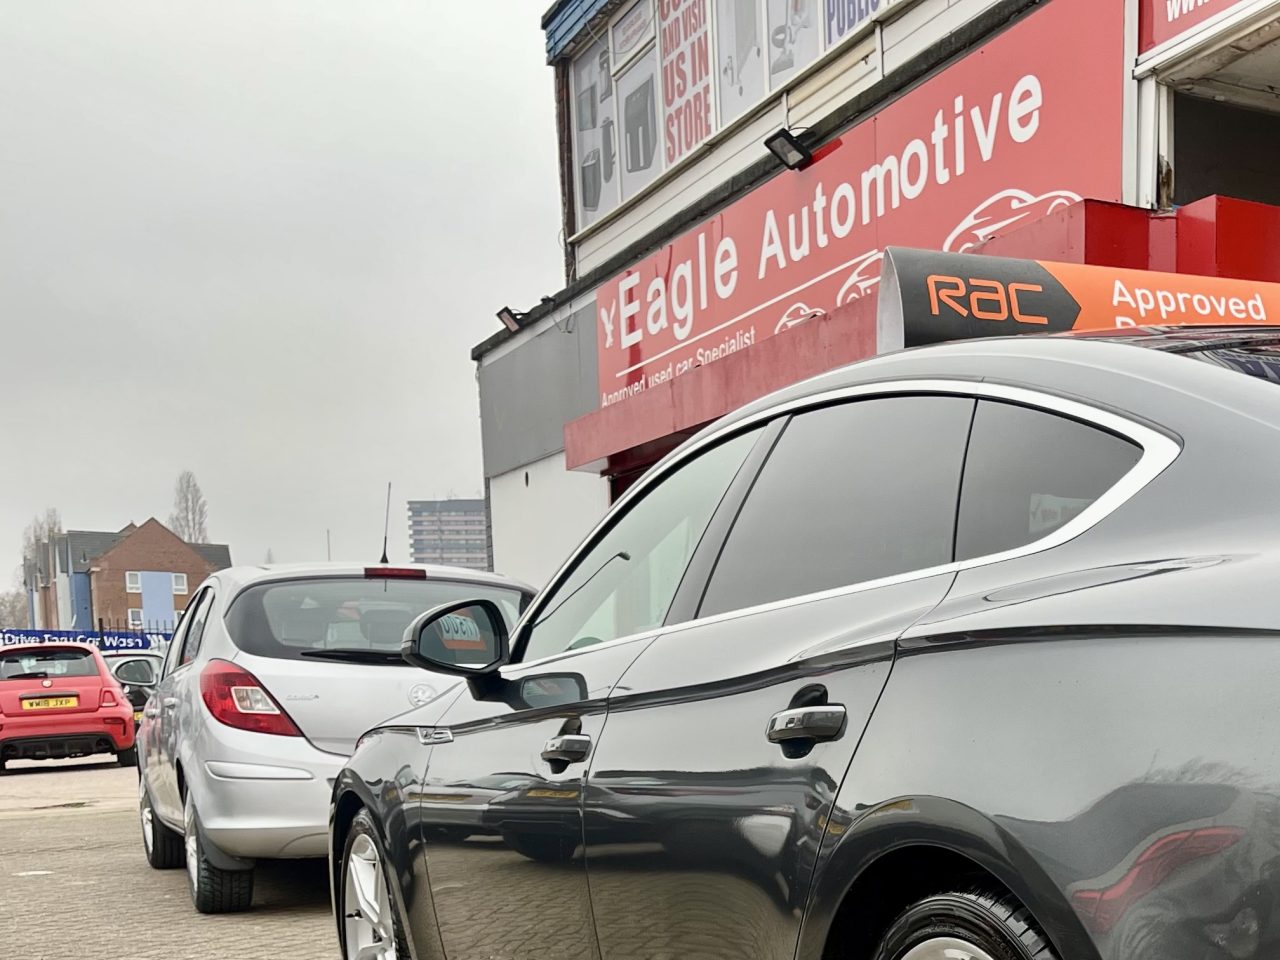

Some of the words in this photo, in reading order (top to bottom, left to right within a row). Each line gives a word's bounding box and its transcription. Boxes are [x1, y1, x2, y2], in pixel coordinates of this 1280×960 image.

[662, 16, 681, 59] AND
[664, 51, 687, 107] US
[690, 30, 710, 87] IN
[666, 83, 711, 164] STORE
[618, 233, 739, 350] Eagle
[758, 74, 1043, 279] Automotive
[1112, 279, 1267, 321] Approved
[648, 363, 673, 388] used
[676, 357, 694, 377] car
[696, 325, 756, 366] Specialist
[4, 633, 39, 645] Drive
[76, 634, 101, 646] Car
